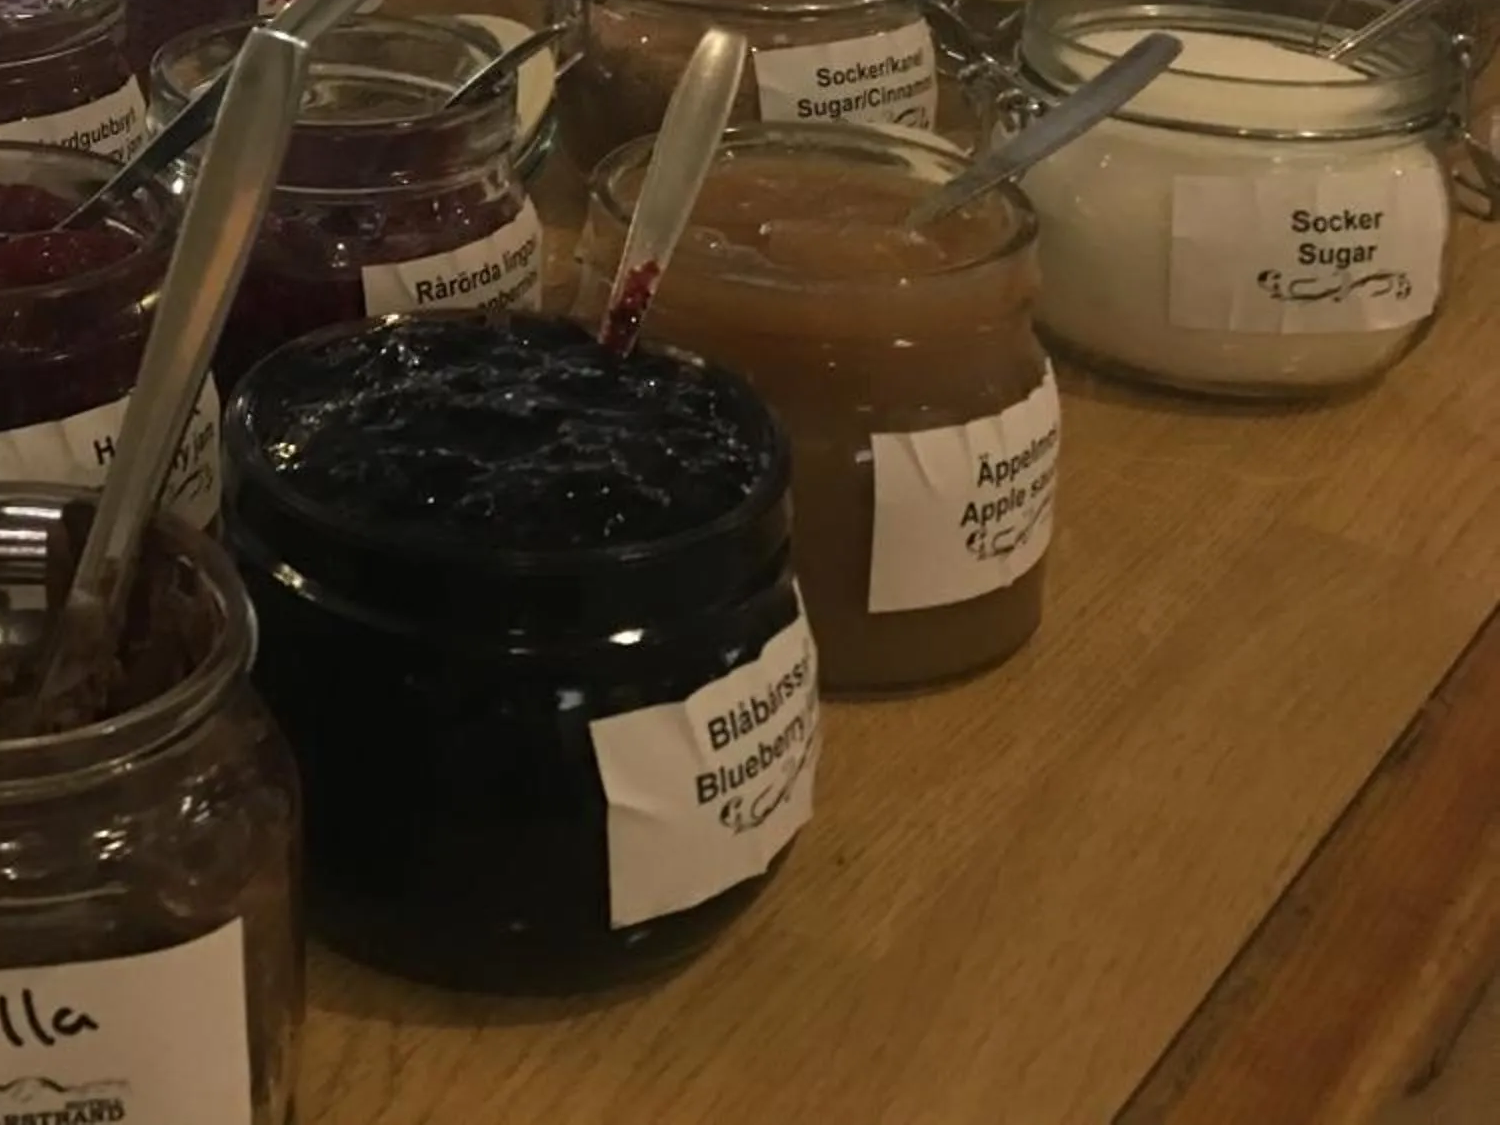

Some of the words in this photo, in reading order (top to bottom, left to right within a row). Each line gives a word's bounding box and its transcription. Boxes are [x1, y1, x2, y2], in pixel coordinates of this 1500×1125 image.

[1291, 209, 1384, 234] Socker
[1298, 242, 1378, 270] Sugar
[415, 262, 501, 305] Rårörda
[960, 486, 1025, 528] Apple
